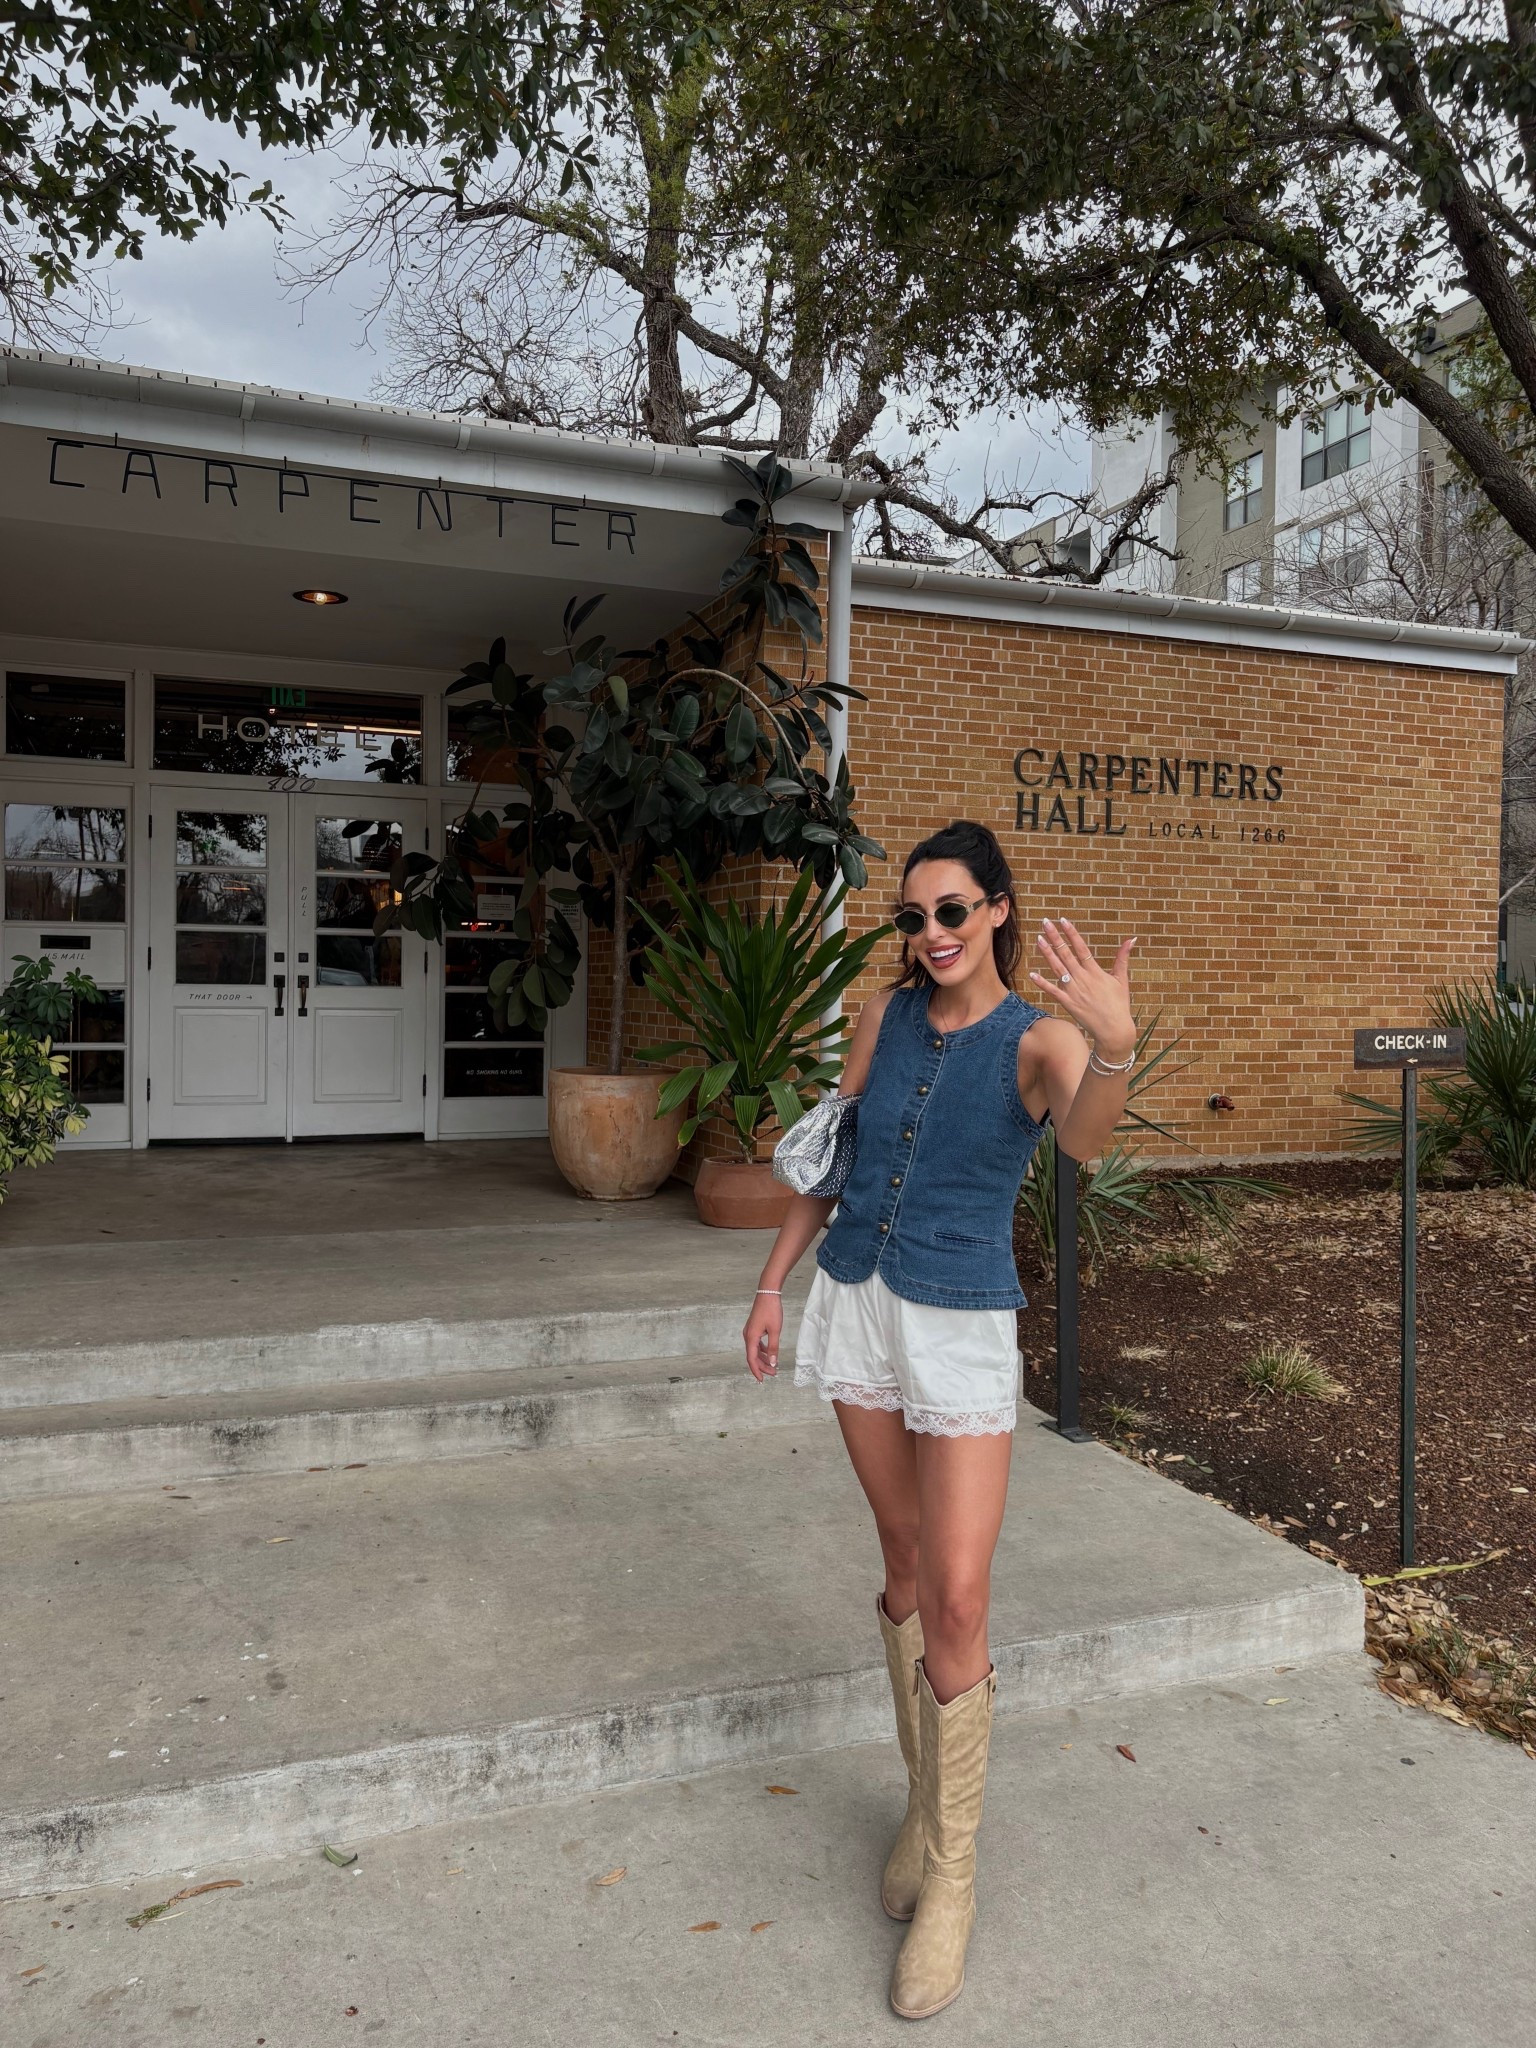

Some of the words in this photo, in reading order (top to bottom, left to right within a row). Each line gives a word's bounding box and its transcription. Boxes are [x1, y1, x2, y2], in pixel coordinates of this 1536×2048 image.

[49, 441, 636, 554] CARPENTER
[197, 714, 382, 750] HOTEL
[267, 776, 319, 792] 400
[1013, 748, 1283, 801] CARPENTERS
[1015, 791, 1127, 834] HALL
[1149, 822, 1220, 840] LOCAL
[1240, 827, 1286, 843] 1266
[1374, 1034, 1447, 1050] CHECK-IN
